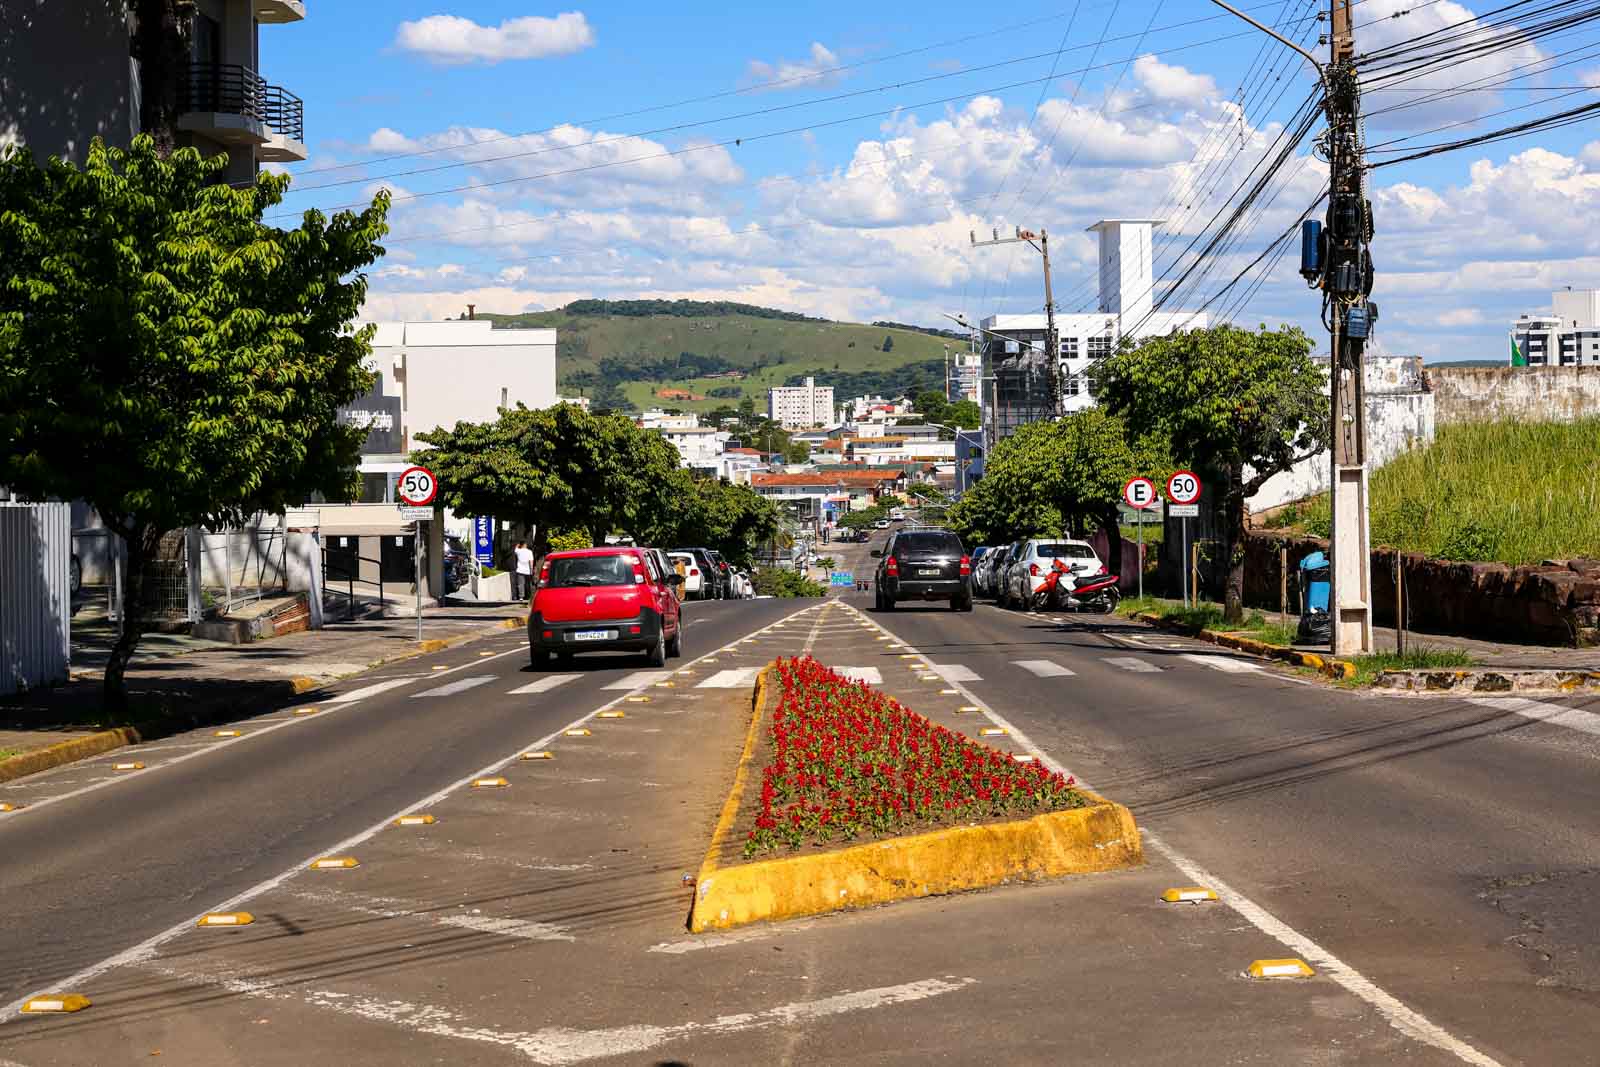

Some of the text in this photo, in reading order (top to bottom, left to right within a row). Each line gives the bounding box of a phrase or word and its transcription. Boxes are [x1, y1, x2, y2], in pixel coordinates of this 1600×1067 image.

[406, 476, 429, 492] 50
[1174, 479, 1194, 493] 50
[1134, 484, 1146, 501] E
